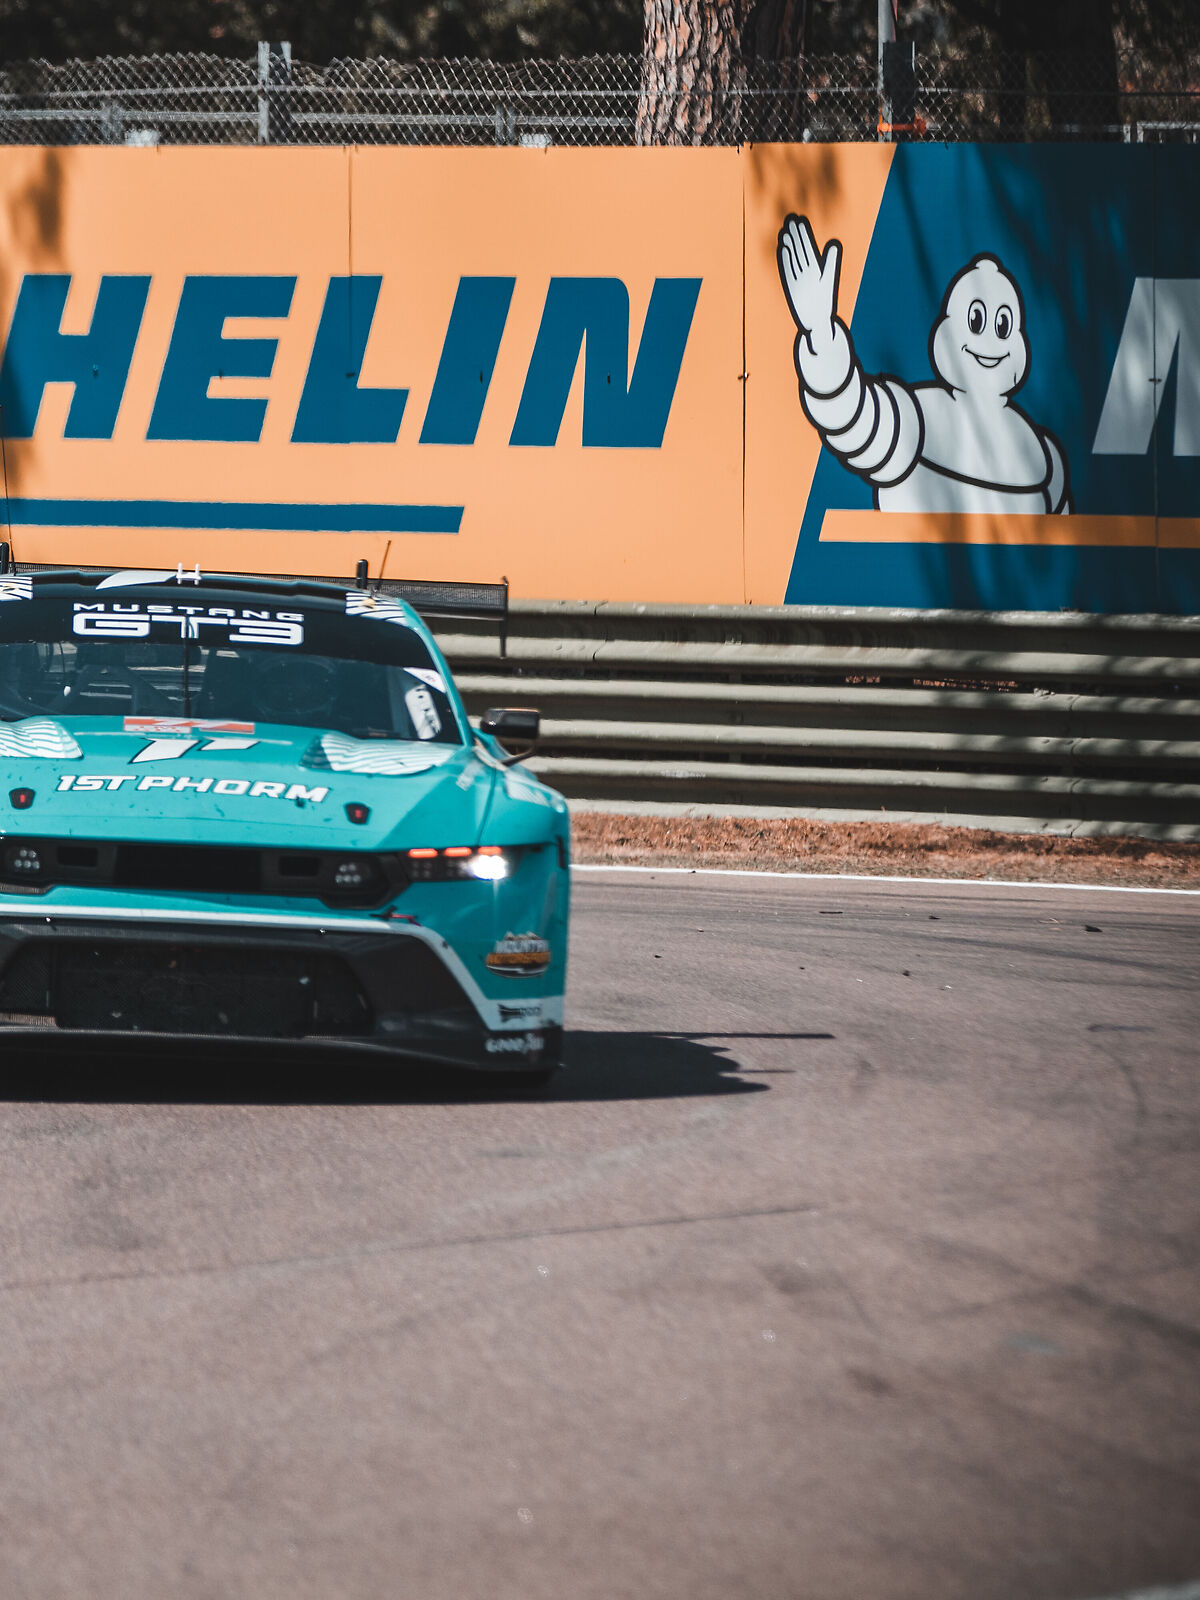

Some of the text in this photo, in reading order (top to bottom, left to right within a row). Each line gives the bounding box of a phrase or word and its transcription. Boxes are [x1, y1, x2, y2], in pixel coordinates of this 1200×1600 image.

[72, 602, 305, 622] MUSTANG
[72, 612, 305, 646] GT3
[56, 774, 331, 803] 1ST PHORM
